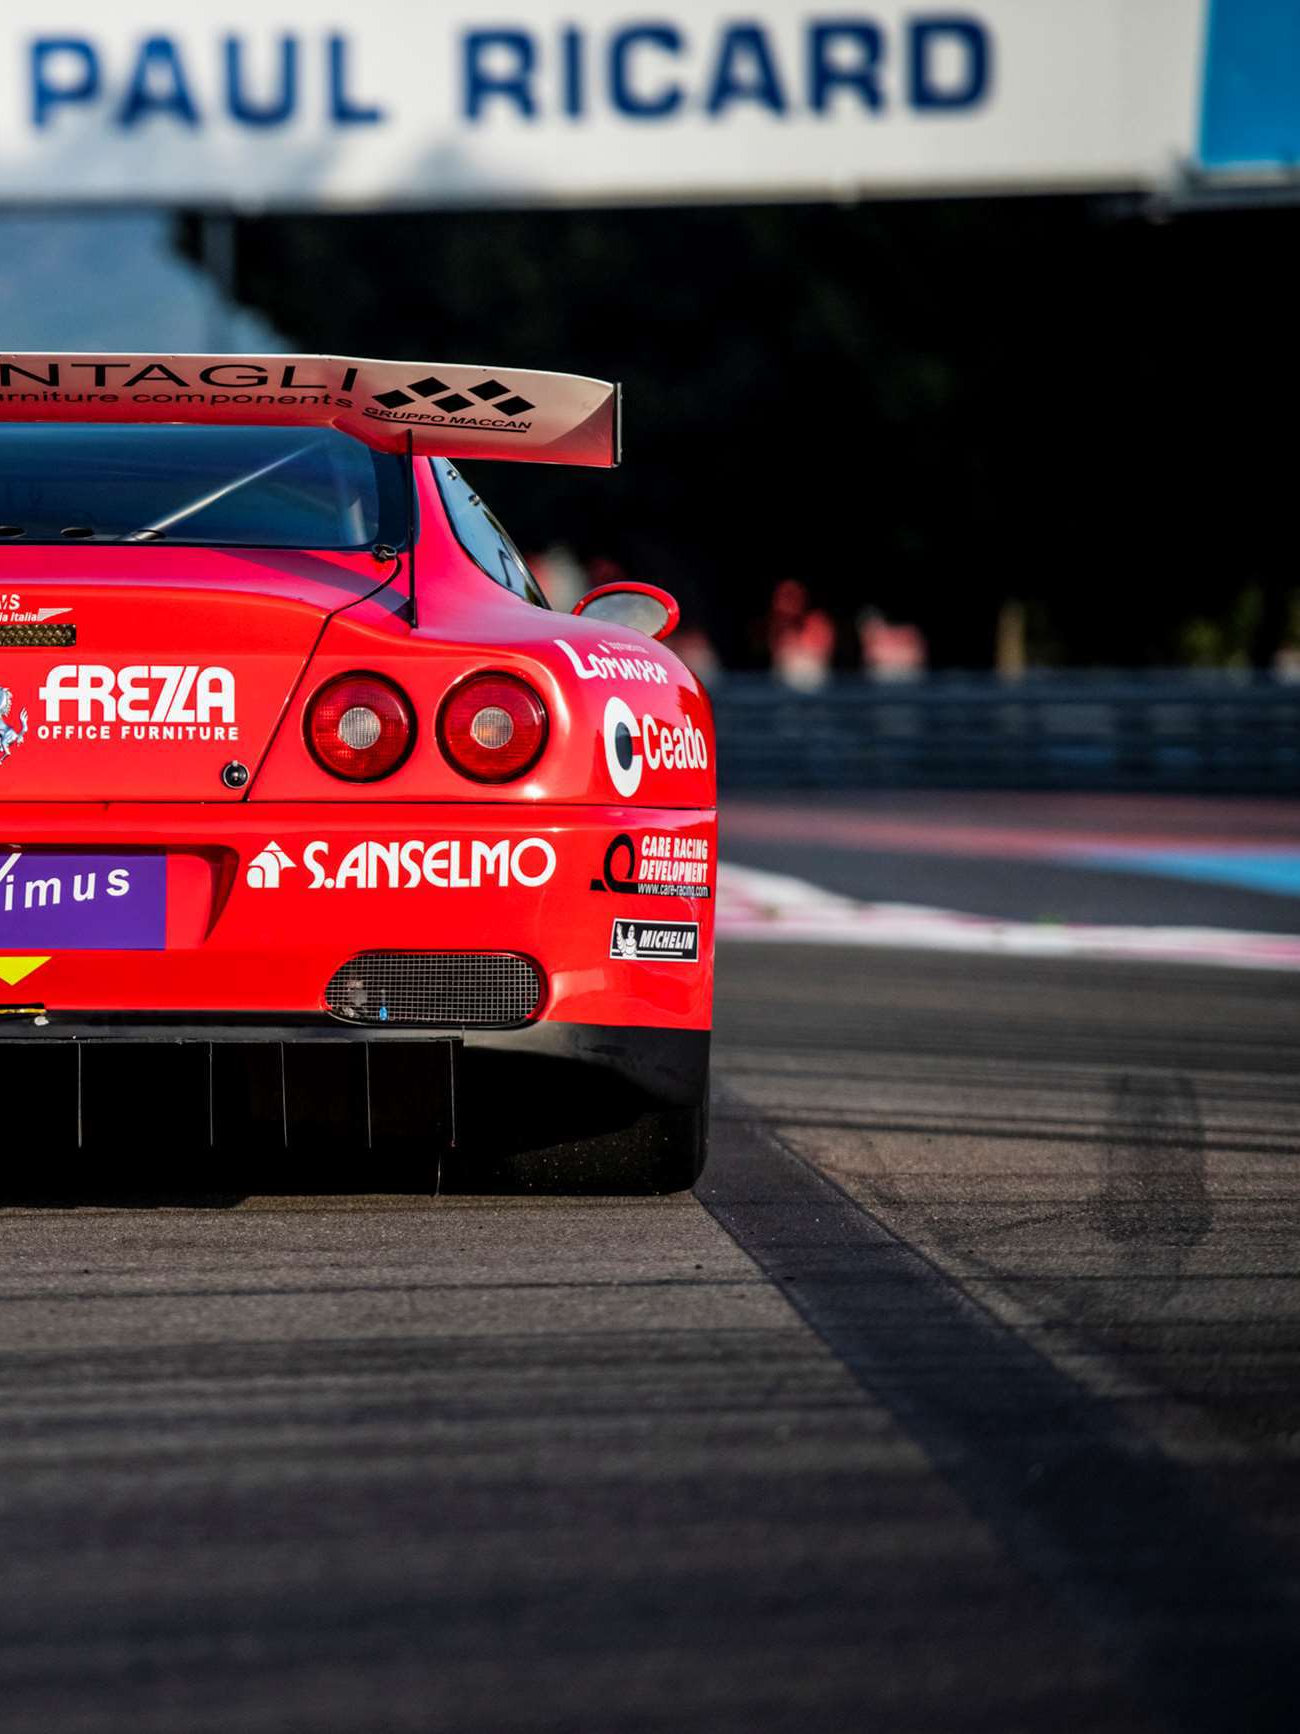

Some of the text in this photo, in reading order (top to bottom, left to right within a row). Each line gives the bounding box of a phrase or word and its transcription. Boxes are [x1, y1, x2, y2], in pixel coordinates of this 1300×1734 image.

[28, 35, 388, 132] PAUL
[462, 15, 996, 122] RICARD
[132, 392, 353, 410] components
[364, 406, 532, 430] GRUPPO MACCAN
[37, 725, 239, 741] OFFICE FURNITURE
[641, 835, 708, 861] CARE RACING
[302, 837, 558, 888] S.ANSELMO
[638, 858, 708, 883] DEVELOPMENT
[638, 930, 696, 950] MICHELIN
